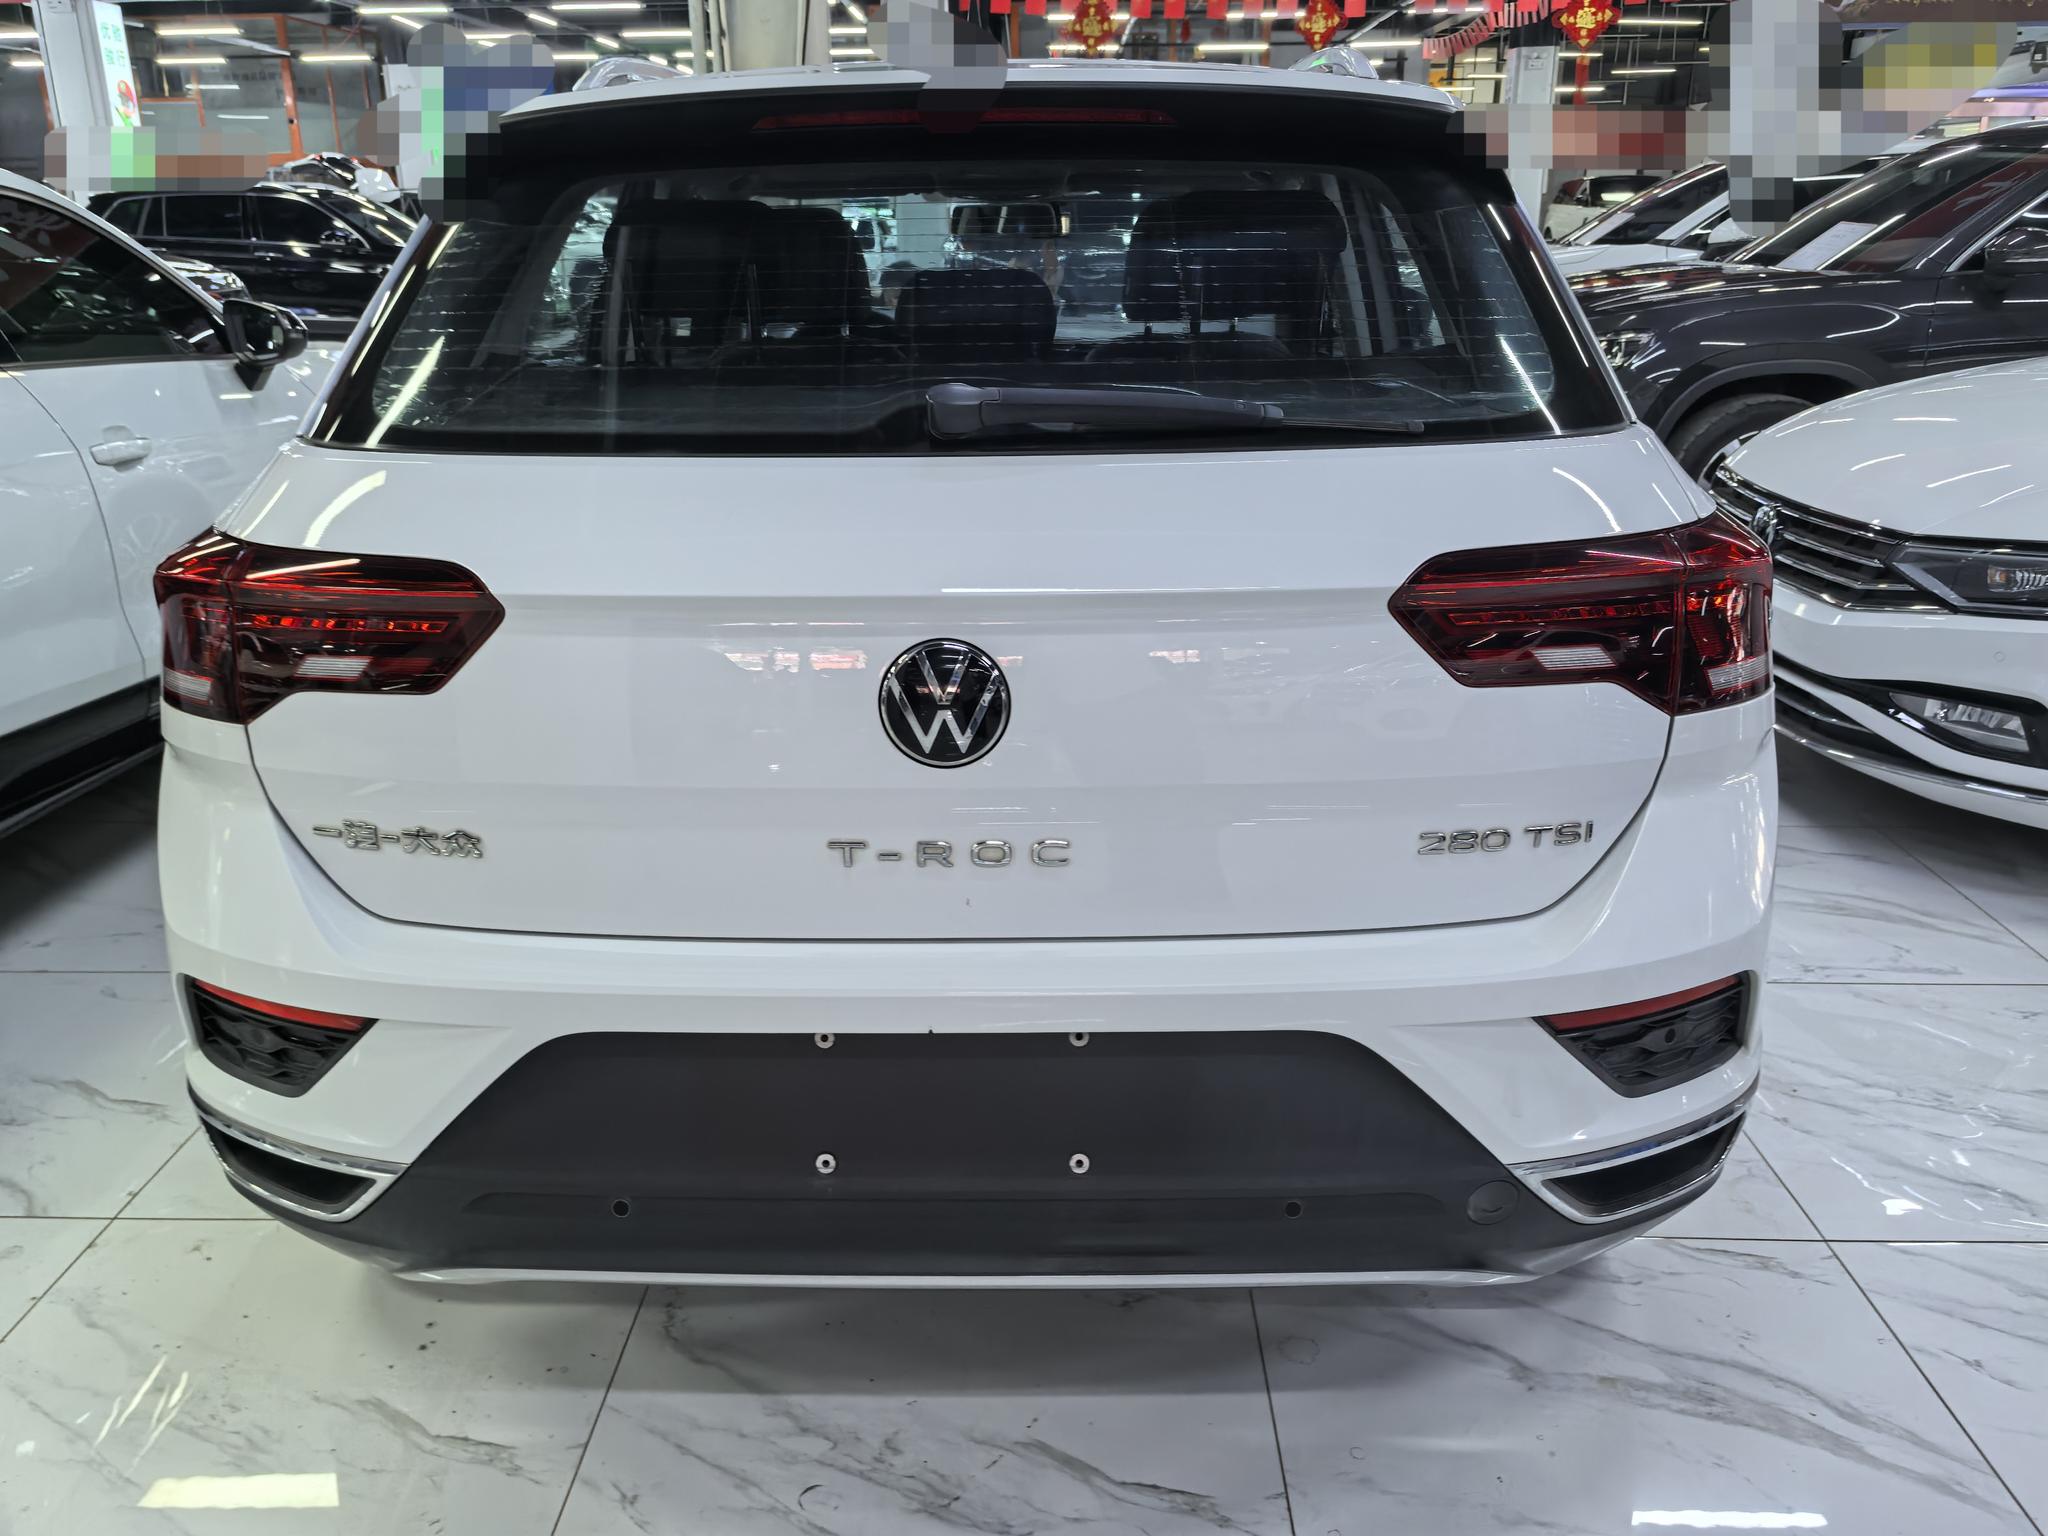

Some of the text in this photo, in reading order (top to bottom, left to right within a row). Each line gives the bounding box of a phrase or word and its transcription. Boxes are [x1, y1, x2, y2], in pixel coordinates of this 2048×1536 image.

[827, 839, 1071, 868] T-ROC
[1417, 820, 1594, 856] 280 TSI
